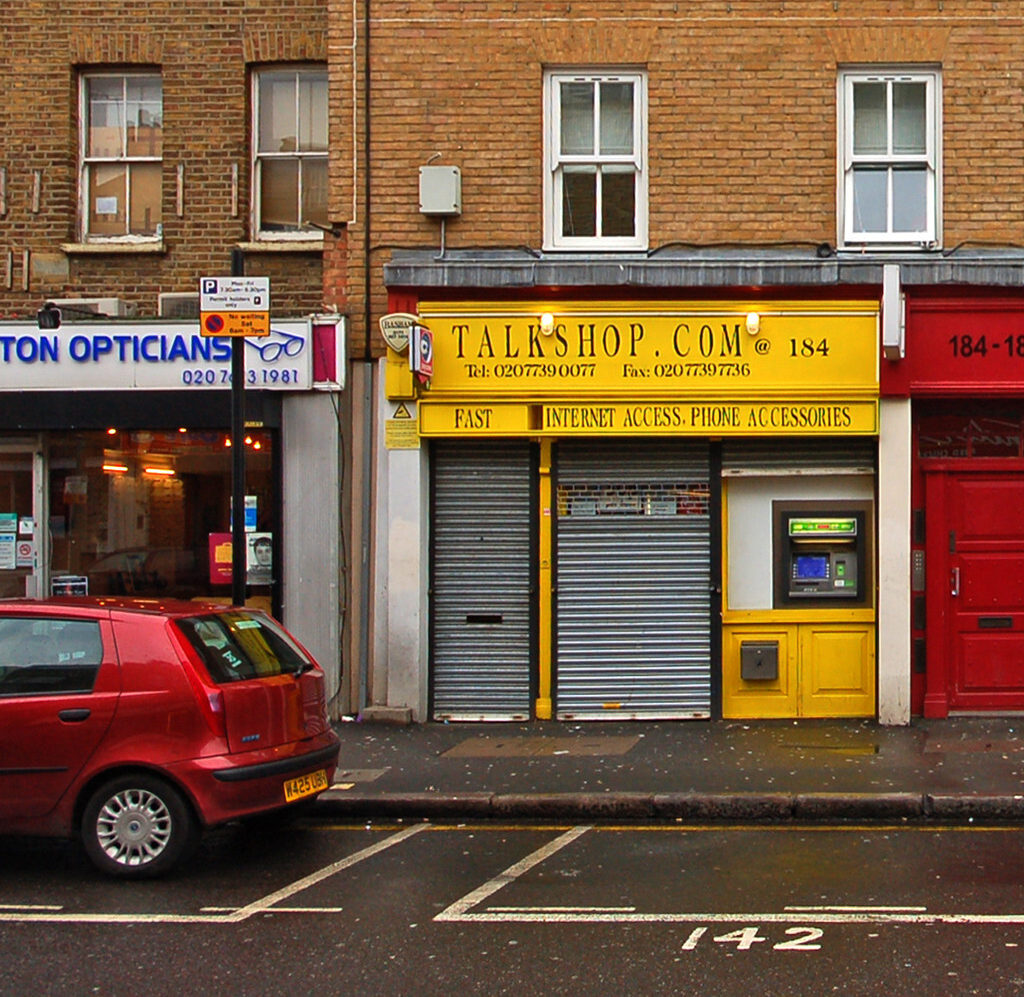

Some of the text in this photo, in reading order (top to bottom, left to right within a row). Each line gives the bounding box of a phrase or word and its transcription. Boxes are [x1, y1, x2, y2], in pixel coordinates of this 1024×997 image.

[205, 281, 215, 293] P
[69, 335, 232, 362] OPTICIANS
[754, 338, 771, 355] @
[790, 338, 830, 357] 184
[183, 369, 215, 384] 020
[262, 369, 298, 384] 1981
[465, 364, 490, 378] Tel:
[623, 364, 651, 378] Fax:
[455, 408, 493, 429] FAST
[546, 407, 616, 428] INTERNET
[691, 407, 740, 427] PHONE
[748, 406, 852, 427] ACCESSORIES
[681, 927, 824, 950] 142
